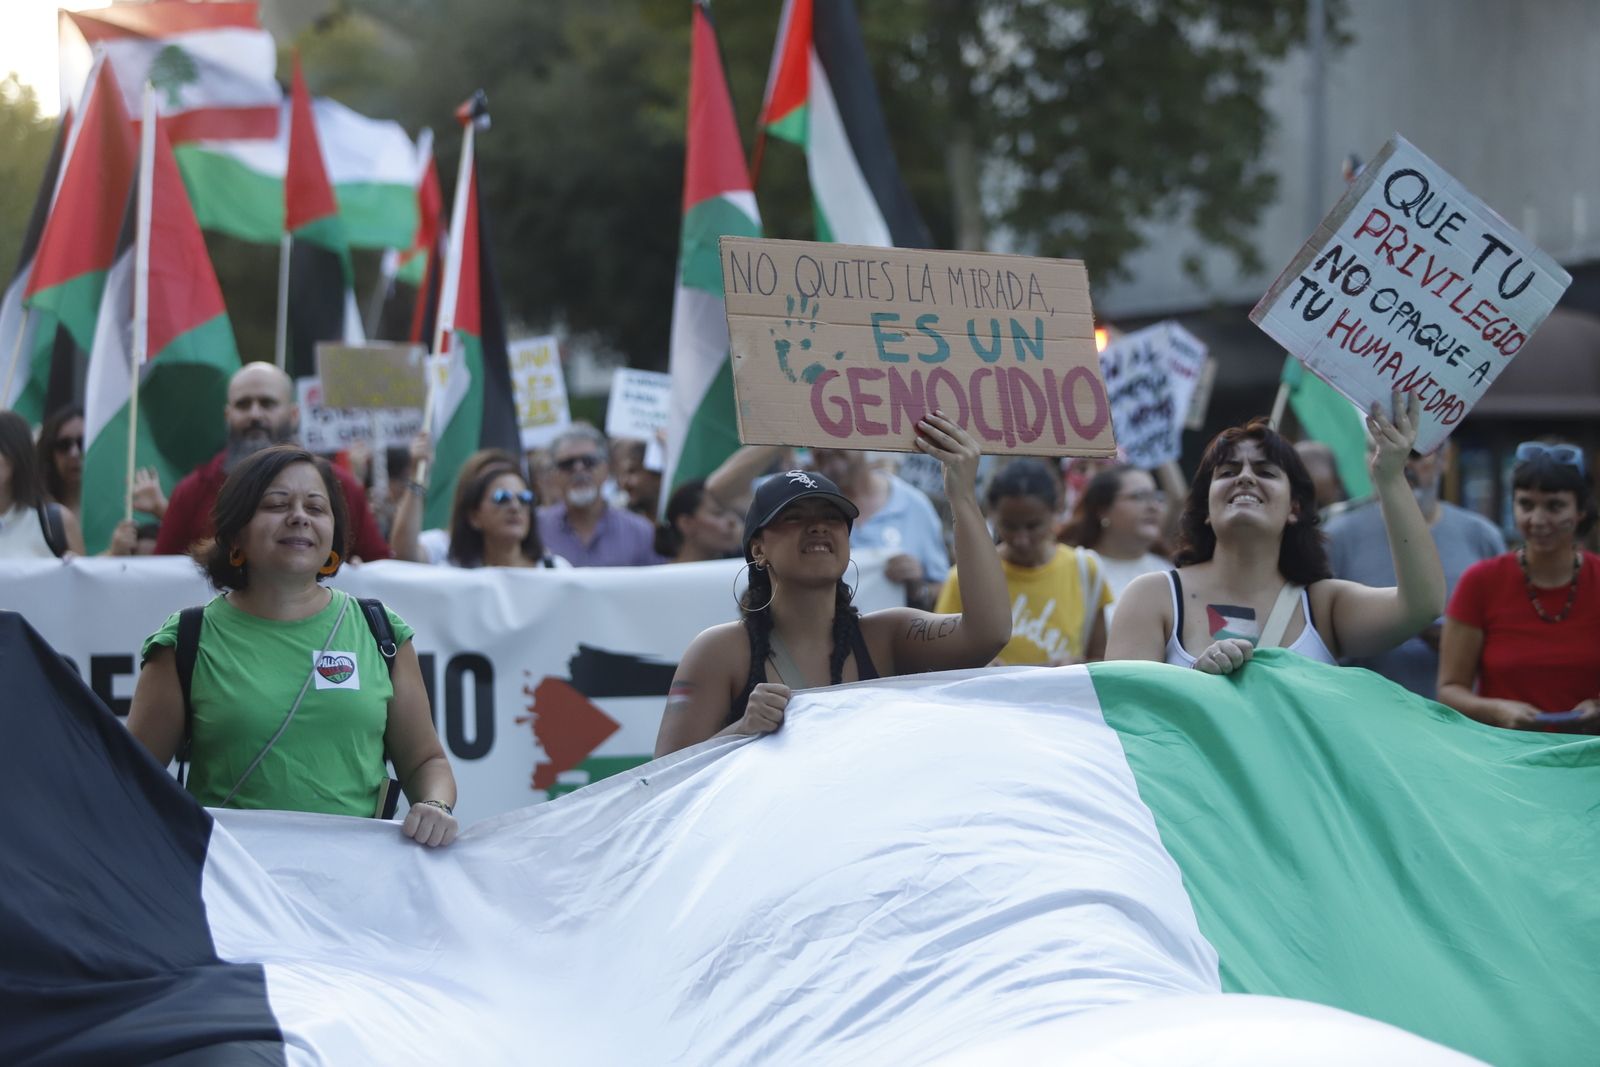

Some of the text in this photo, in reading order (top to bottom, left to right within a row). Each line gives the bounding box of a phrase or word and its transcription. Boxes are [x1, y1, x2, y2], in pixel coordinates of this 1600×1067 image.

[731, 250, 1055, 317] NO QUITES LA MIRADA,
[1353, 207, 1528, 357] PRIVILEGIO
[1384, 168, 1536, 300] QUE TU
[870, 312, 1044, 364] ES UN
[1289, 275, 1465, 426] TU HUMANIDAD
[1313, 244, 1491, 387] NO OPAQUE A
[811, 366, 1110, 449] GENOCIDIO
[905, 616, 964, 642] PALES
